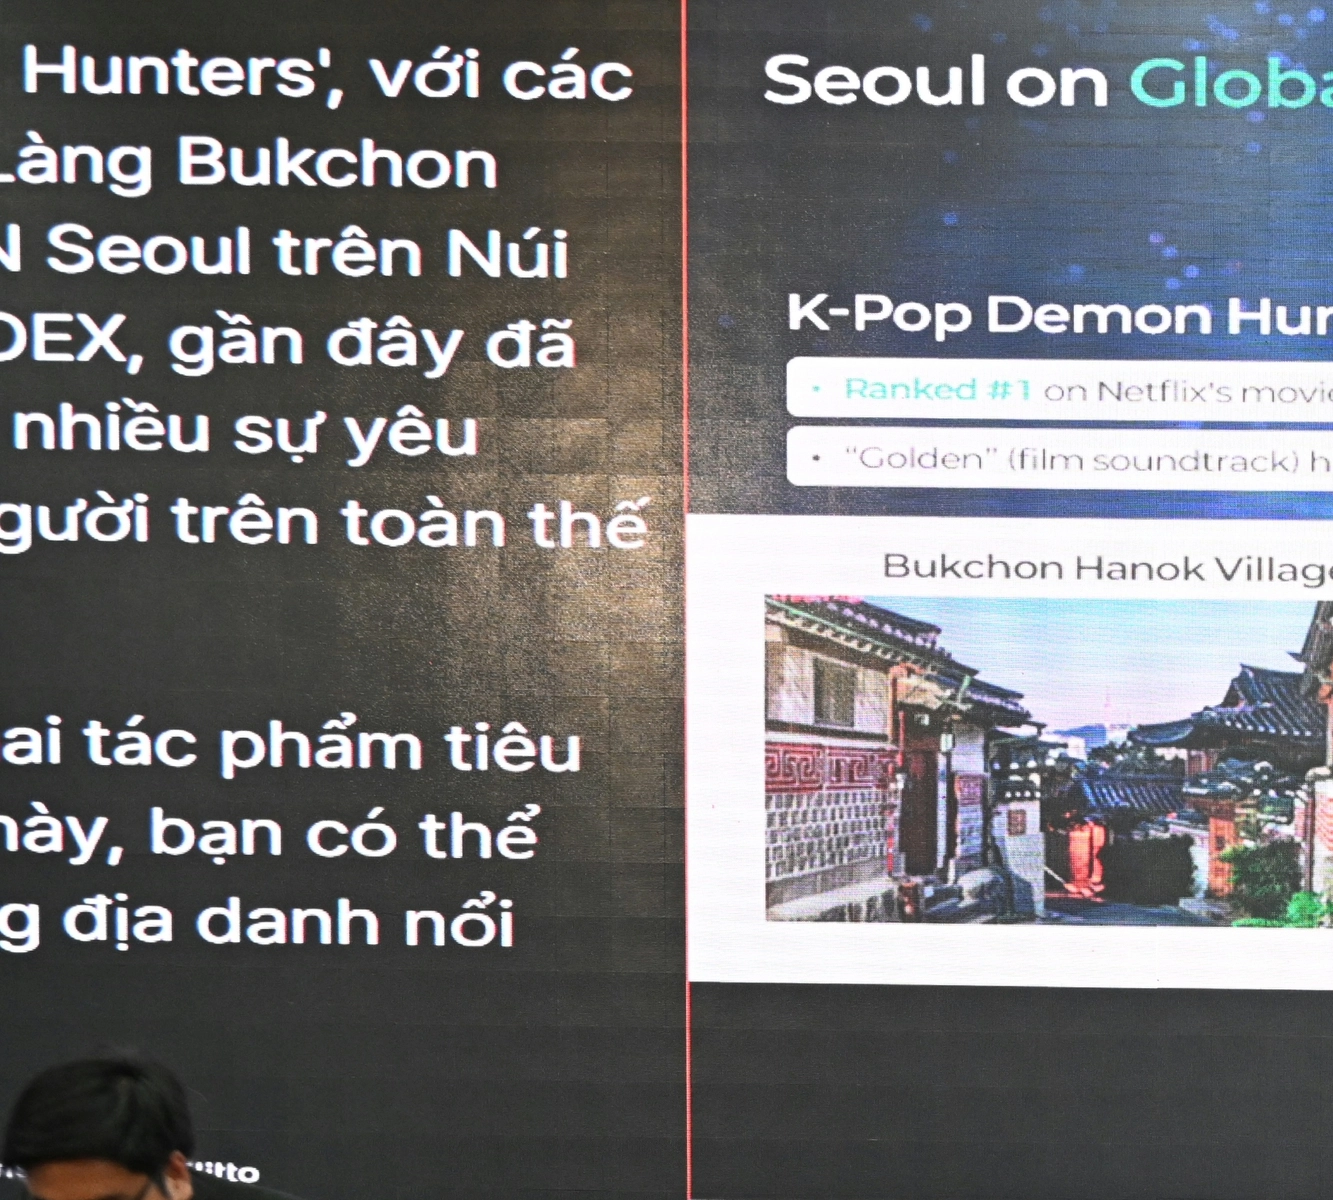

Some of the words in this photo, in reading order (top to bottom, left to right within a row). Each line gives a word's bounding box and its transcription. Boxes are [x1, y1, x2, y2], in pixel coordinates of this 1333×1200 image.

[24, 44, 343, 110] Hunters',
[369, 45, 479, 98] với
[503, 47, 633, 102] các
[764, 53, 985, 107] Seoul
[1006, 67, 1108, 108] on
[179, 135, 497, 189] Bukchon
[47, 223, 250, 275] Seoul
[272, 224, 421, 278] trên
[449, 226, 568, 279] Núi
[169, 309, 303, 377] gần
[327, 315, 464, 379] đây
[486, 318, 575, 369] đã
[788, 293, 972, 342] K-Pop
[987, 295, 1212, 335] Demon
[845, 376, 979, 402] Ranked
[989, 378, 1032, 401] #1
[1044, 384, 1088, 404] on
[1098, 379, 1233, 404] Netflix's
[14, 397, 209, 453] nhiều
[234, 410, 327, 464] sự
[344, 404, 478, 468] yêu
[1007, 445, 1085, 474] (film
[1093, 446, 1300, 475] soundtrack)
[170, 493, 318, 545] trên
[340, 494, 505, 548] toàn
[527, 495, 649, 549] thế
[884, 553, 1063, 579] Bukchon
[1076, 556, 1204, 581] Hanok
[2, 715, 62, 765] ai
[83, 714, 197, 768] tác
[221, 711, 422, 780] phẩm
[444, 721, 581, 773] tiêu
[151, 806, 282, 865] bạn
[307, 806, 397, 858] có
[418, 803, 541, 860] thể
[63, 892, 173, 951] địa
[197, 896, 379, 945] danh
[406, 890, 513, 947] nổi
